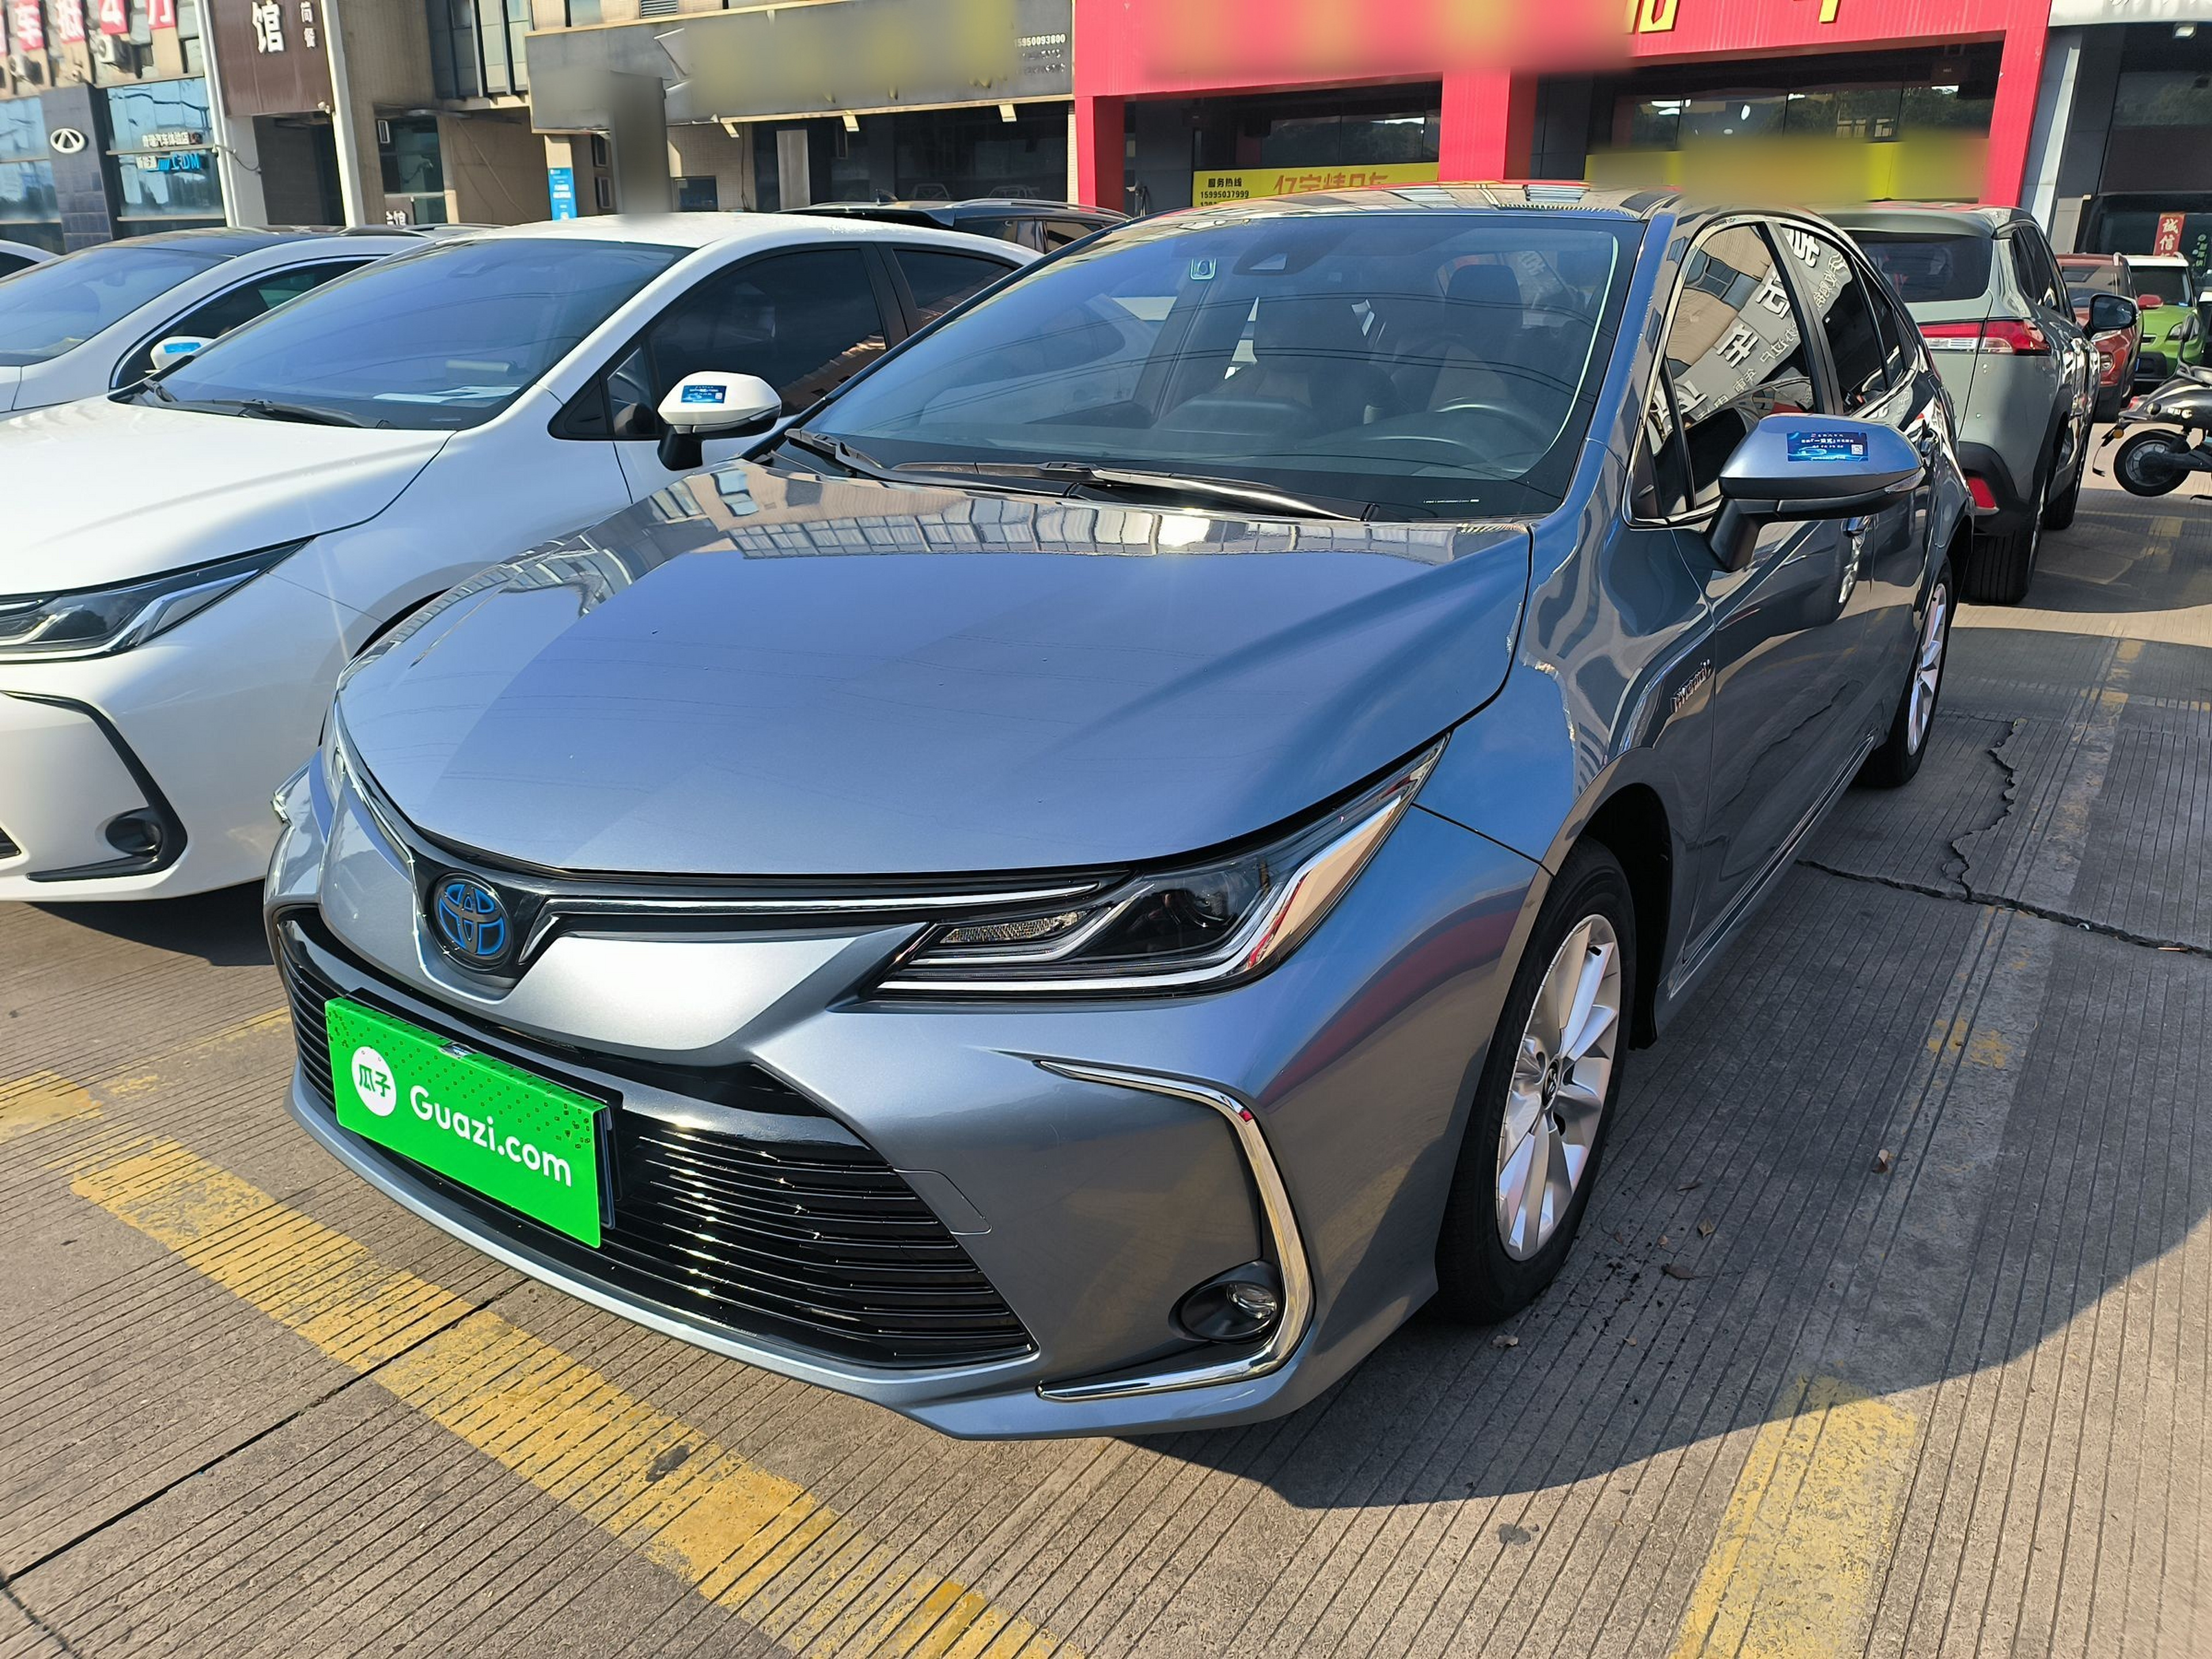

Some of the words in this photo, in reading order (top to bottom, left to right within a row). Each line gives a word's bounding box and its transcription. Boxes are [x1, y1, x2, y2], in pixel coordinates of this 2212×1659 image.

[1208, 177, 1242, 187] 服务热线
[358, 1065, 391, 1097] 瓜子
[410, 1085, 571, 1187] Guazi.com
